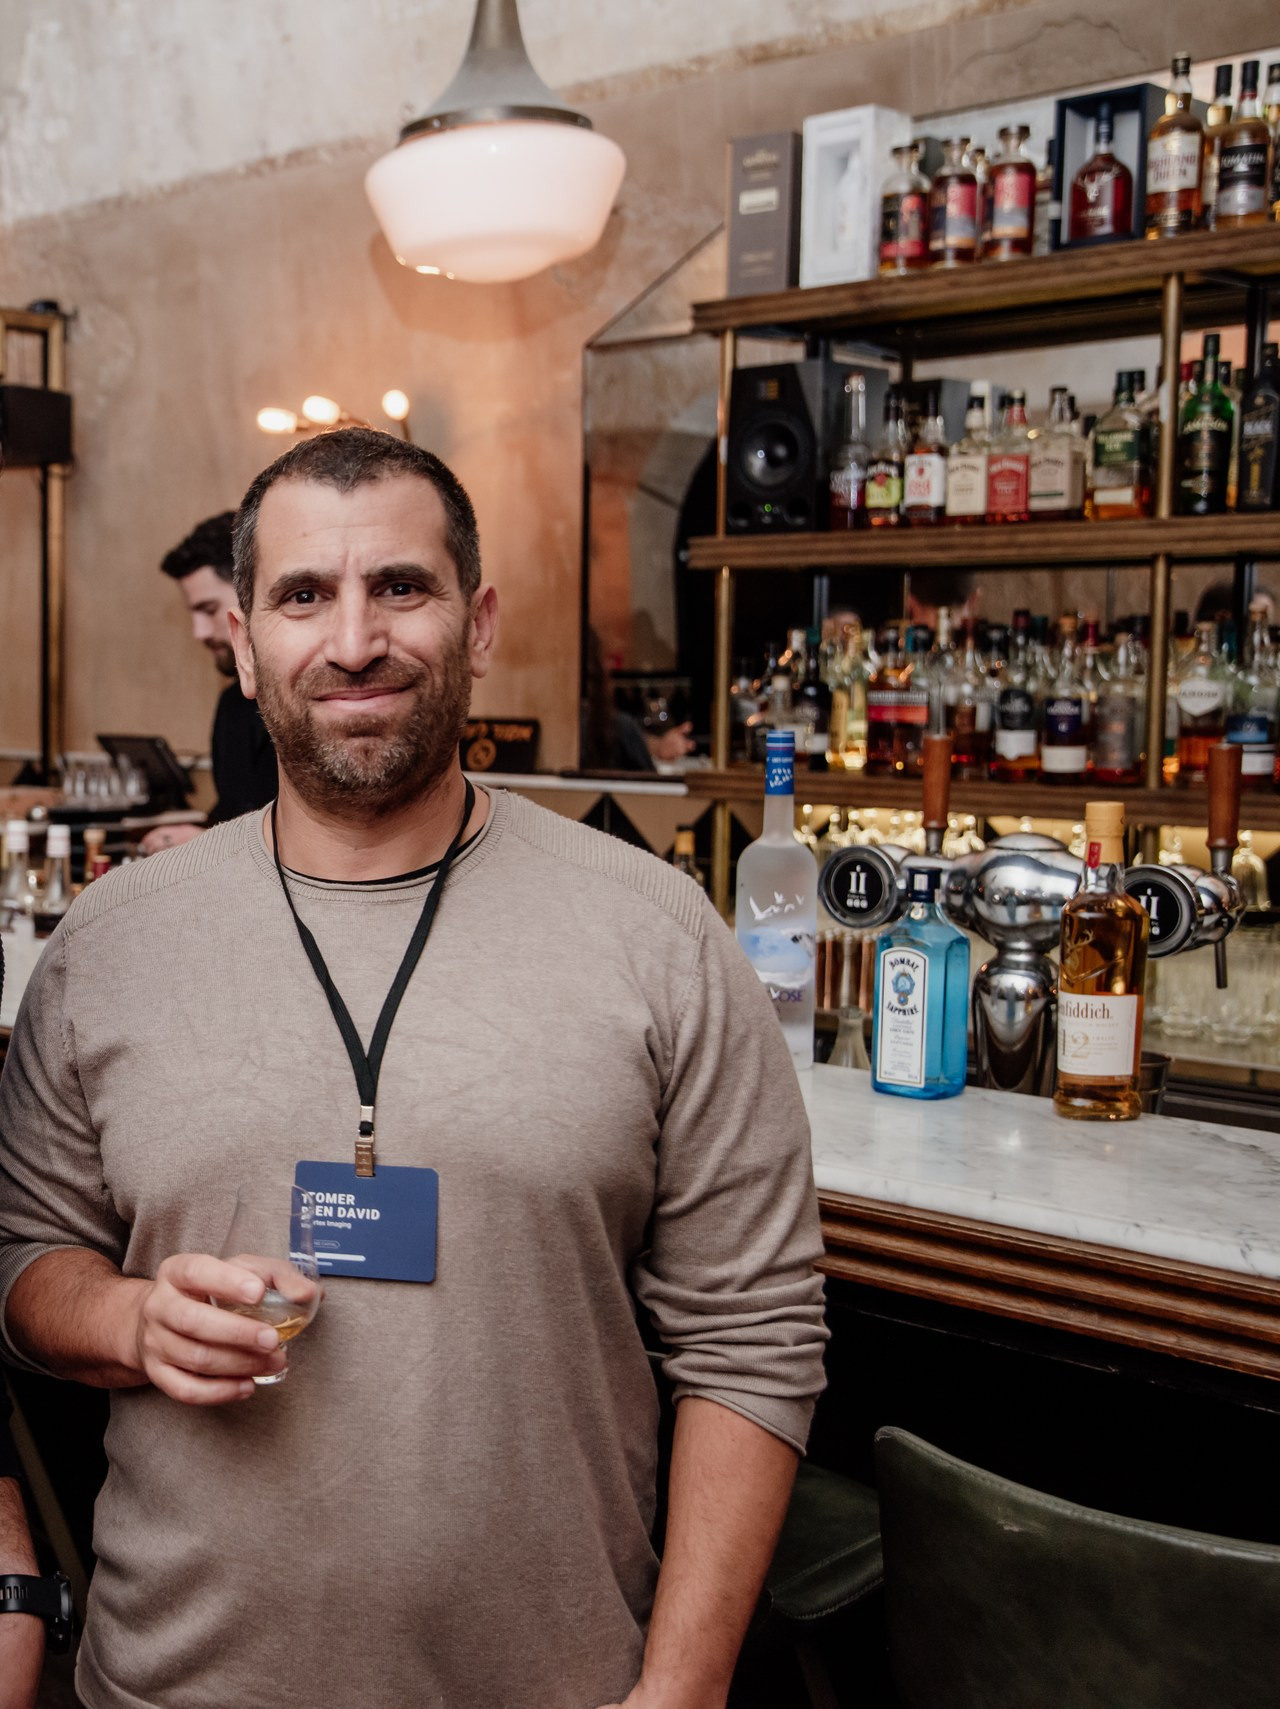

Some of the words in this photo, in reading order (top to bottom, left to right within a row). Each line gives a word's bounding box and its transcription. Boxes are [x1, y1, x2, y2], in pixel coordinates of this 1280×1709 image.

[888, 957, 920, 972] BOMBAY
[885, 1001, 920, 1017] SAPPHIRE
[1059, 1000, 1110, 1019] nfiddich
[337, 1207, 381, 1220] DAVID
[327, 1221, 352, 1230] Imaging
